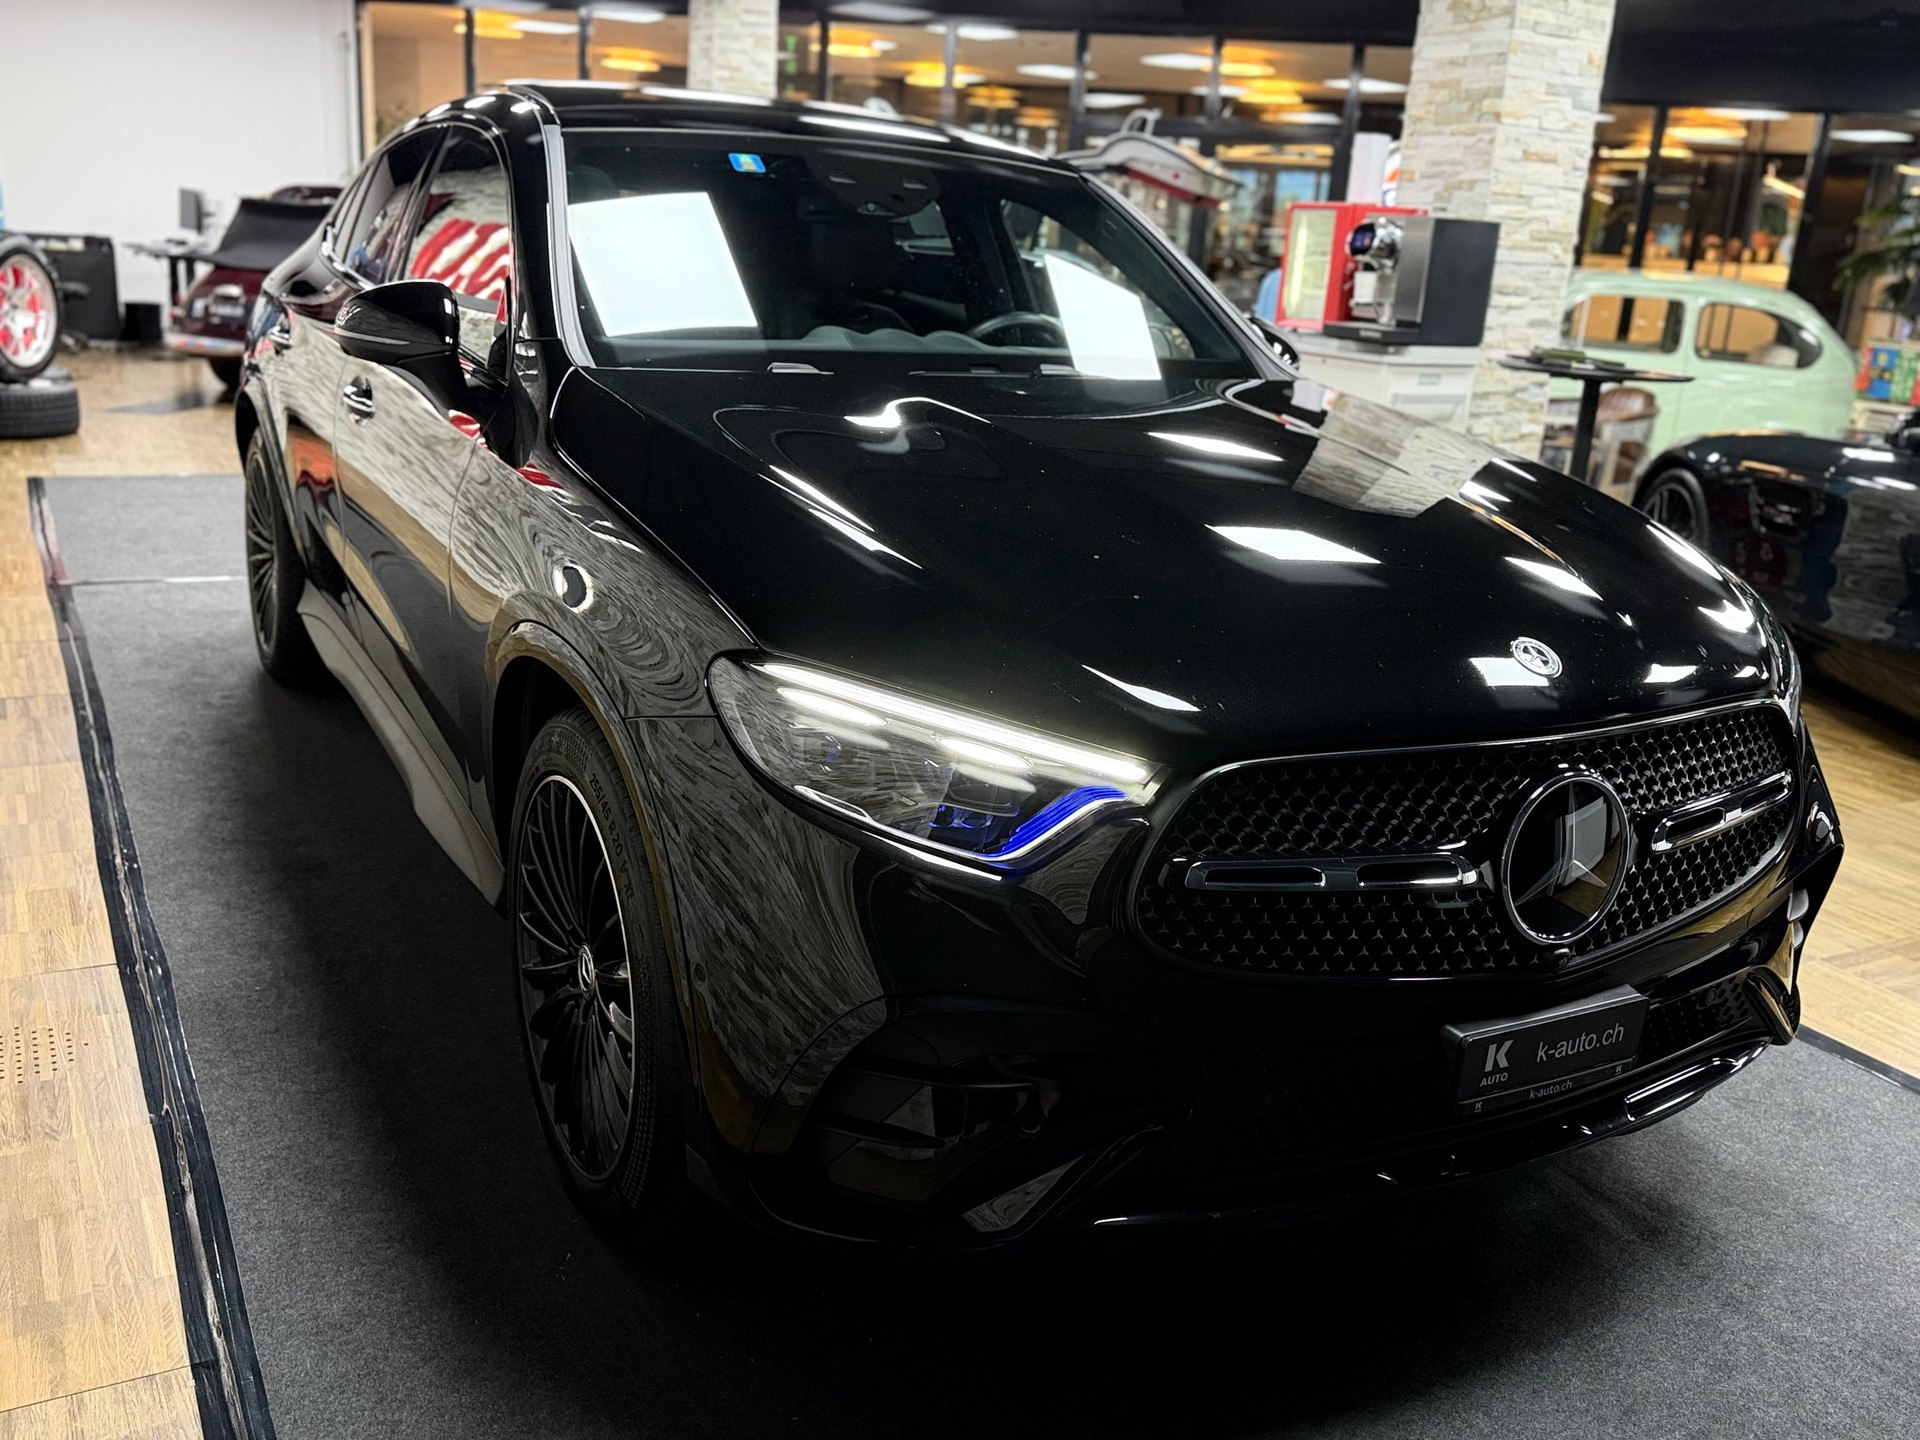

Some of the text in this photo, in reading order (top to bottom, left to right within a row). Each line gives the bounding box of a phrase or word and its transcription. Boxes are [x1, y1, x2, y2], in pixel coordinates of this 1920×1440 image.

[1484, 1039, 1514, 1073] K
[1536, 1022, 1625, 1063] k-auto.ch
[1479, 1072, 1509, 1088] AUTO
[1529, 1079, 1573, 1100] k-auto.ch
